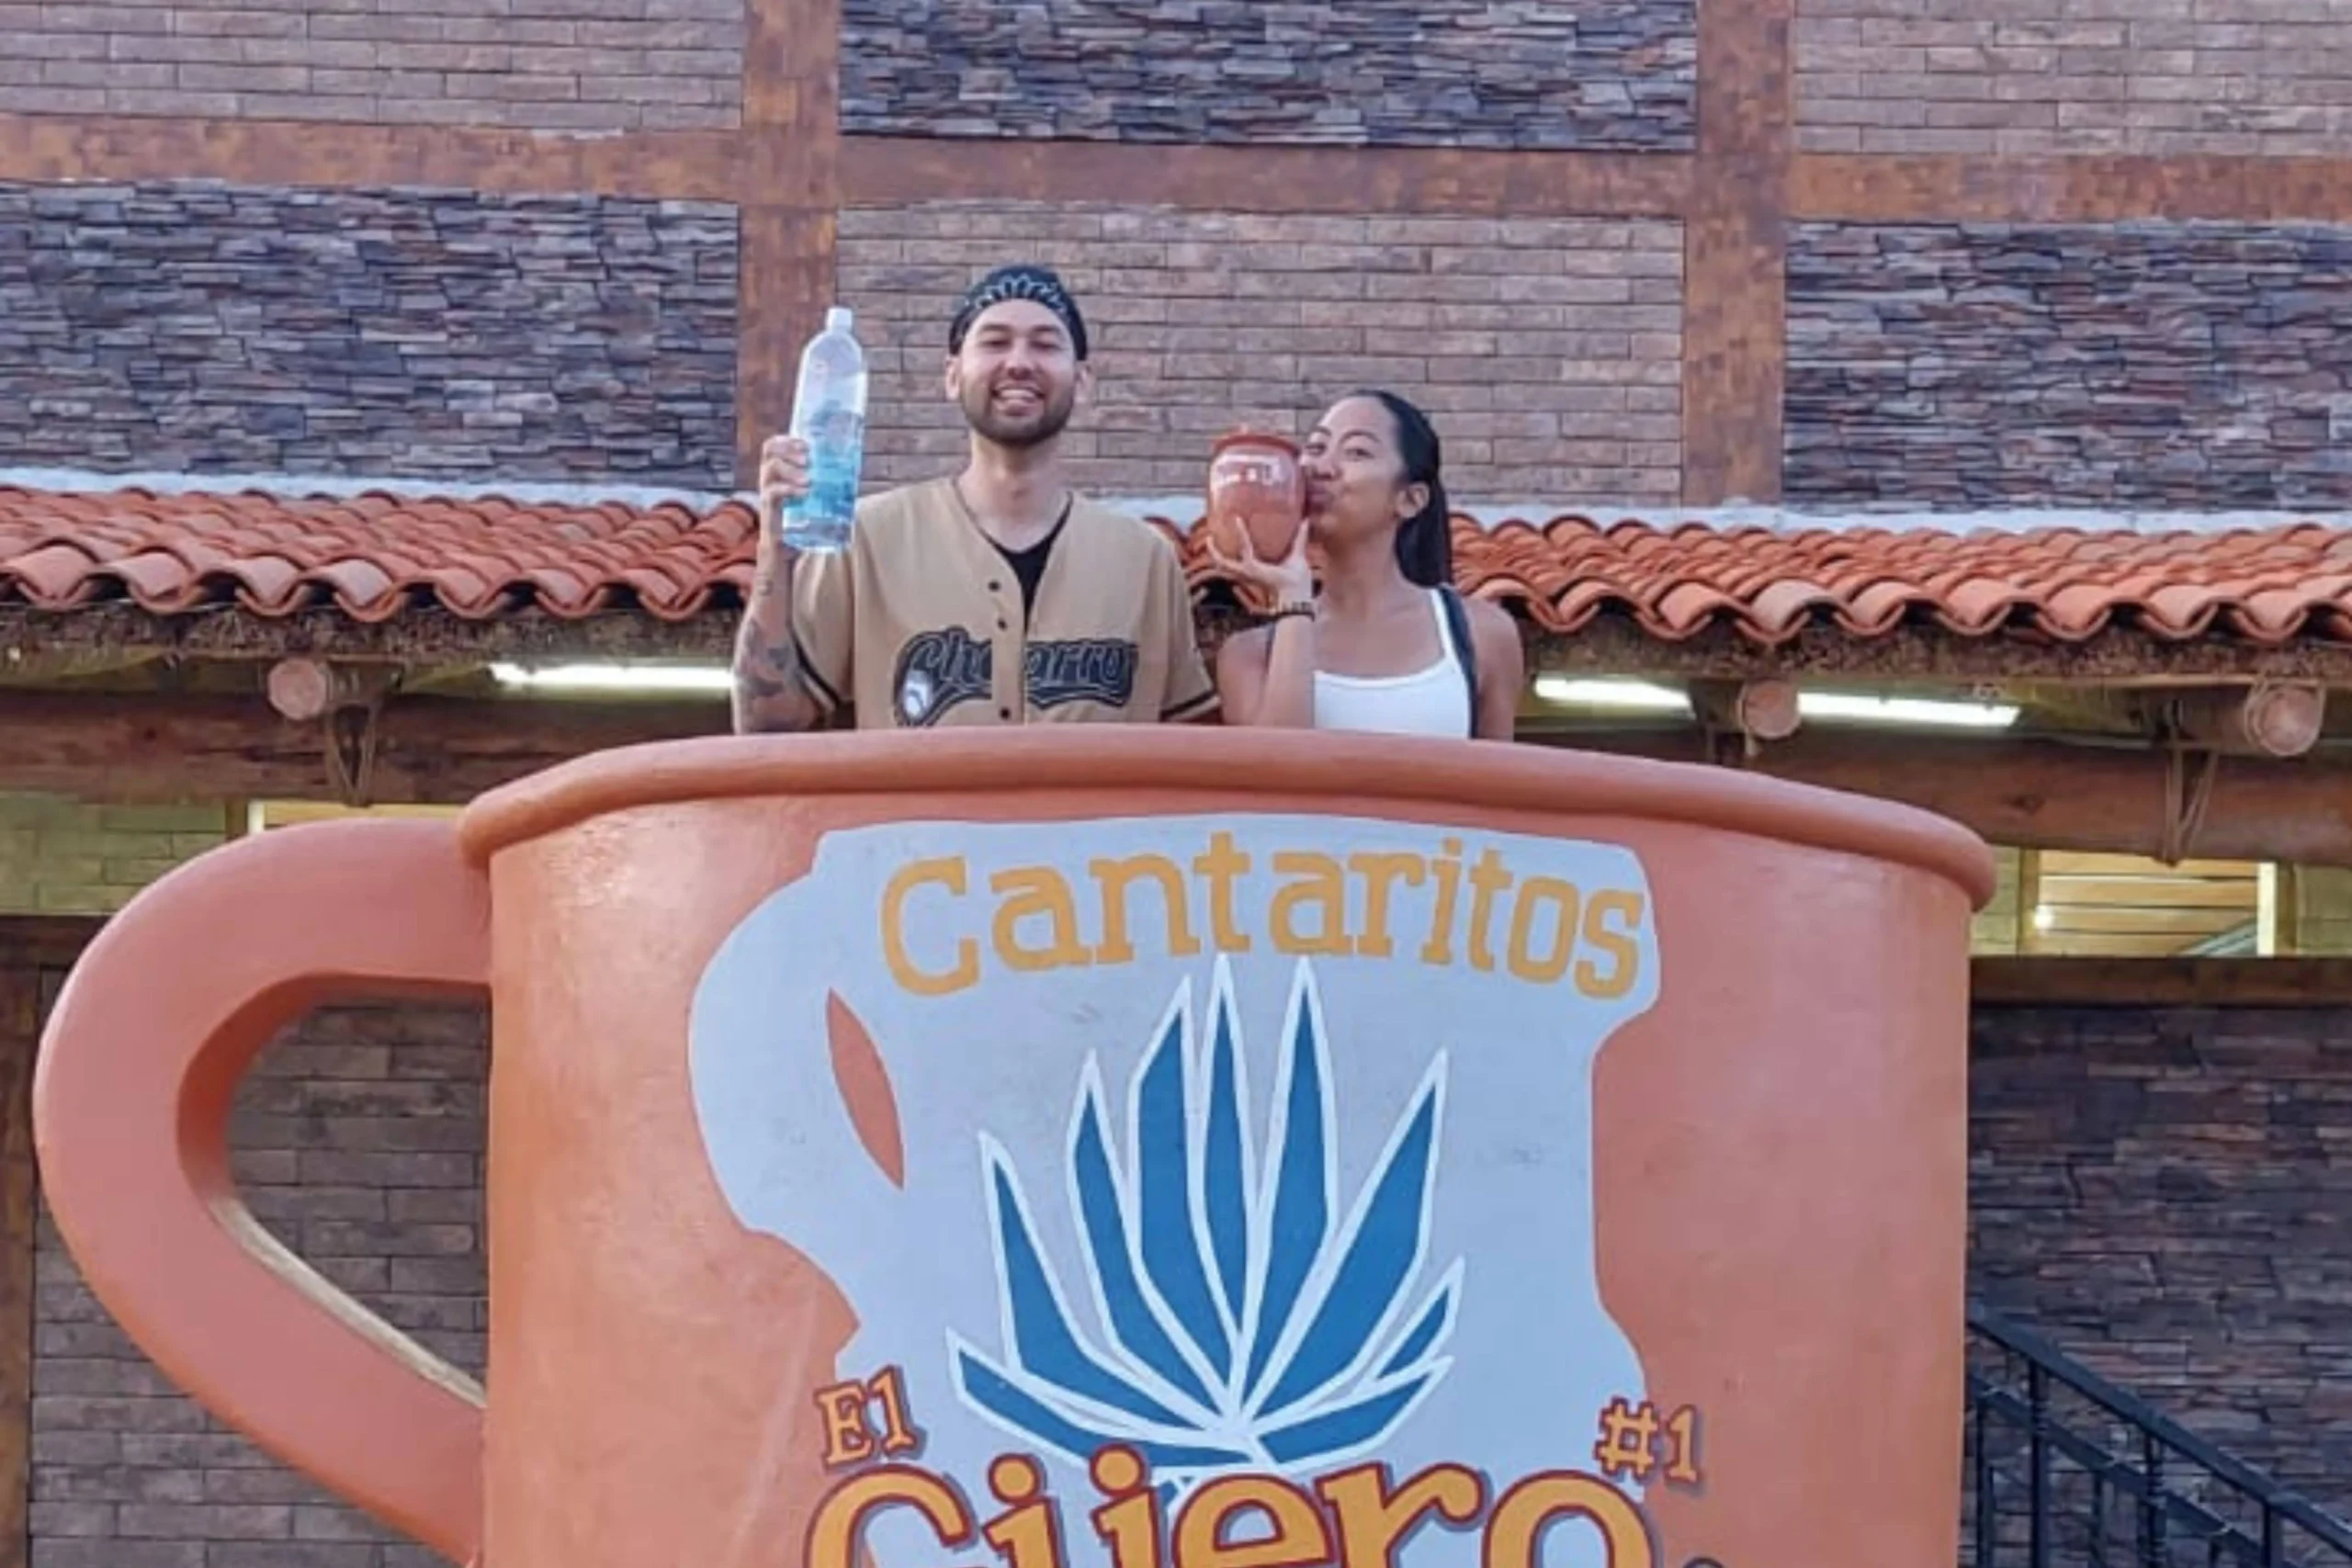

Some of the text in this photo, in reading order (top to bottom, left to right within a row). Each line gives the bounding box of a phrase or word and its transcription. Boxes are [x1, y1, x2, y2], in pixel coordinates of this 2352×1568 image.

[879, 830, 1645, 1000] Cantaritos
[815, 1365, 917, 1466] El
[1592, 1395, 1703, 1484] #1
